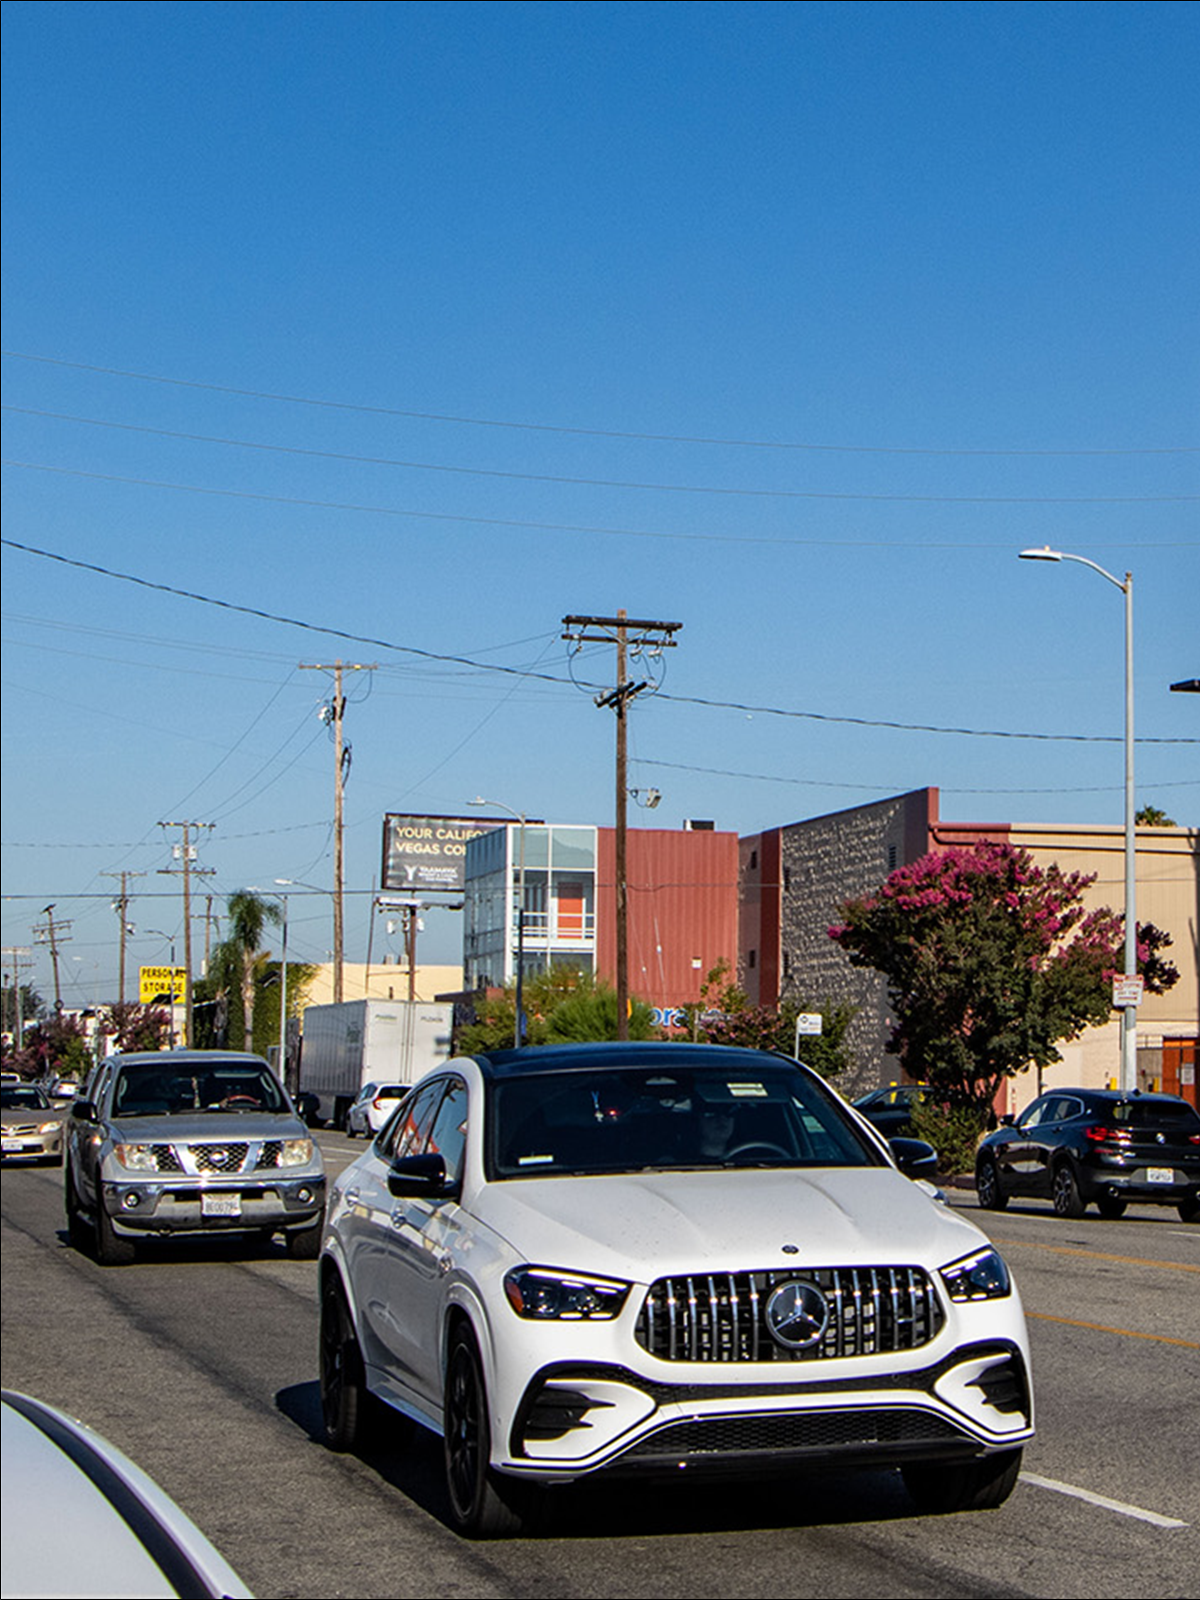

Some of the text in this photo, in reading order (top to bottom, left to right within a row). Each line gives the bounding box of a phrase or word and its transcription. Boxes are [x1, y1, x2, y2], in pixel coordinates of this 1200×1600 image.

[396, 827, 488, 841] YOUR CALIFO
[395, 841, 440, 855] VEGAS
